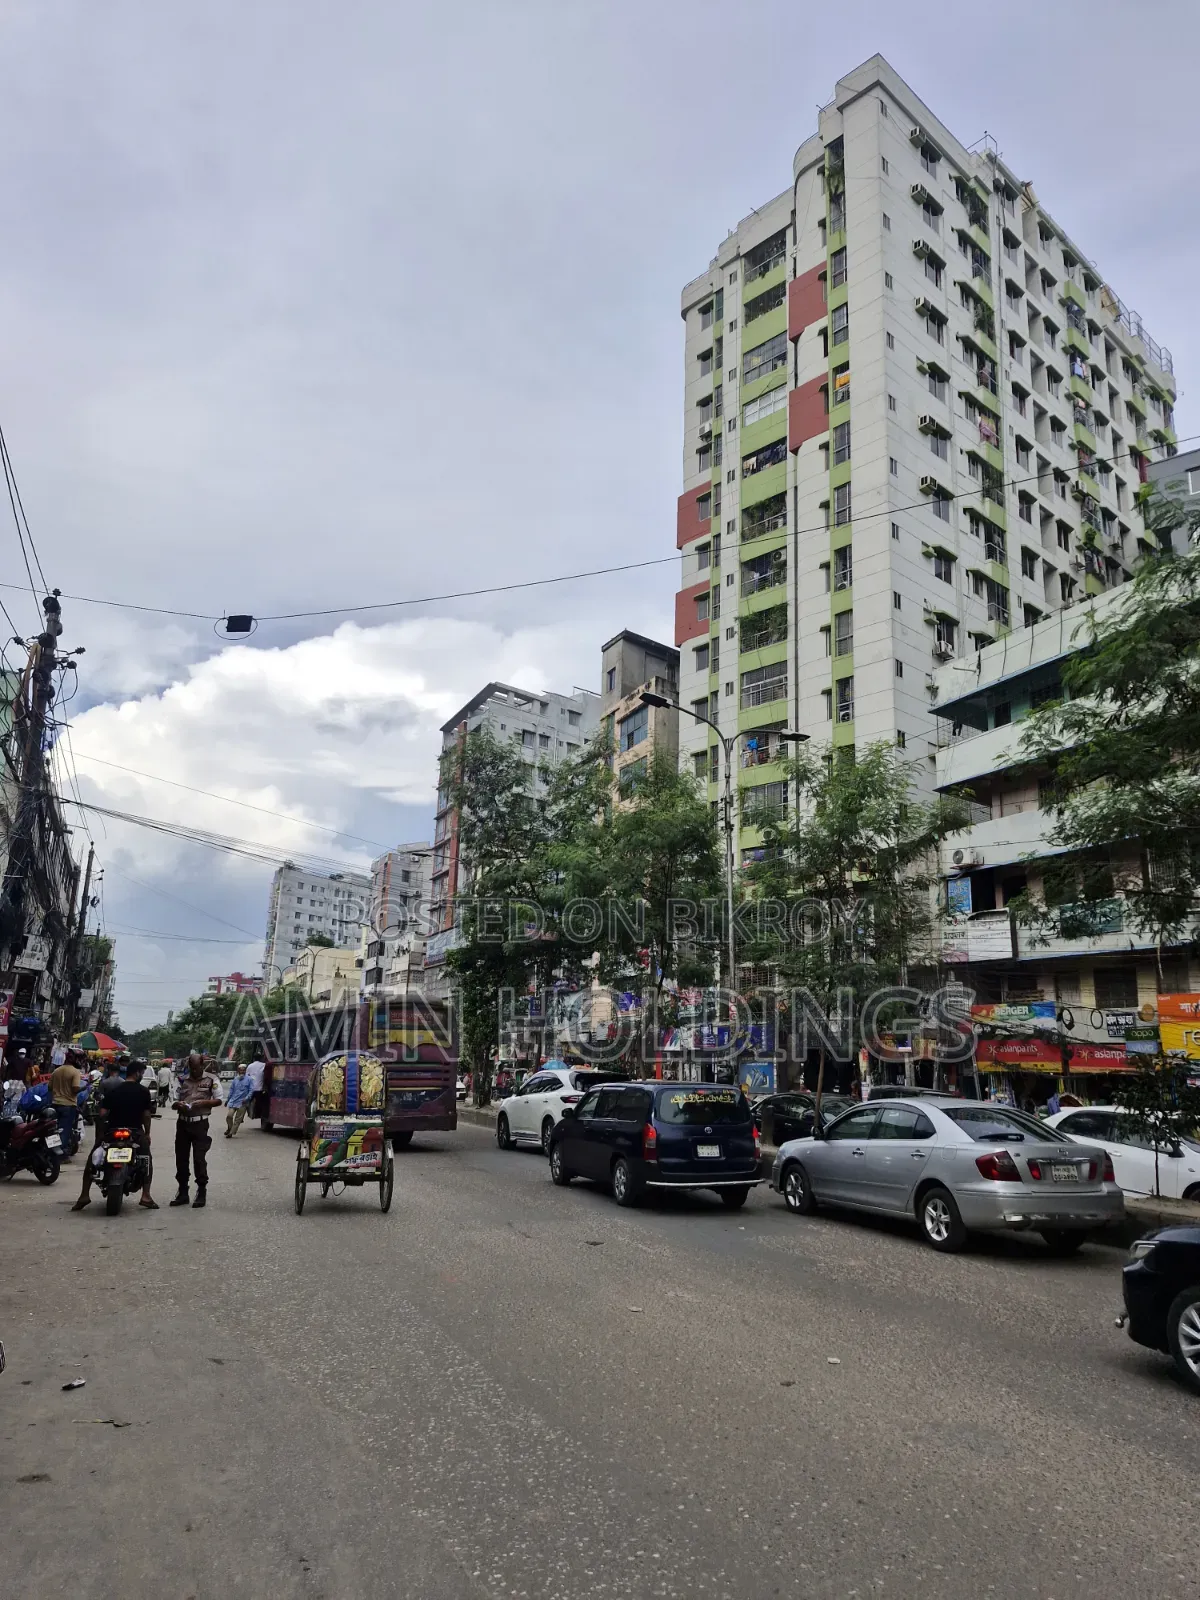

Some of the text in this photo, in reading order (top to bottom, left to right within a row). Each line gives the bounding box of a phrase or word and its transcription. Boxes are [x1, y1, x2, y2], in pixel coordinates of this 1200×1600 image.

[994, 1006, 1029, 1016] BERGER
[1131, 1029, 1154, 1039] oppo
[1000, 1044, 1038, 1056] asianpaints
